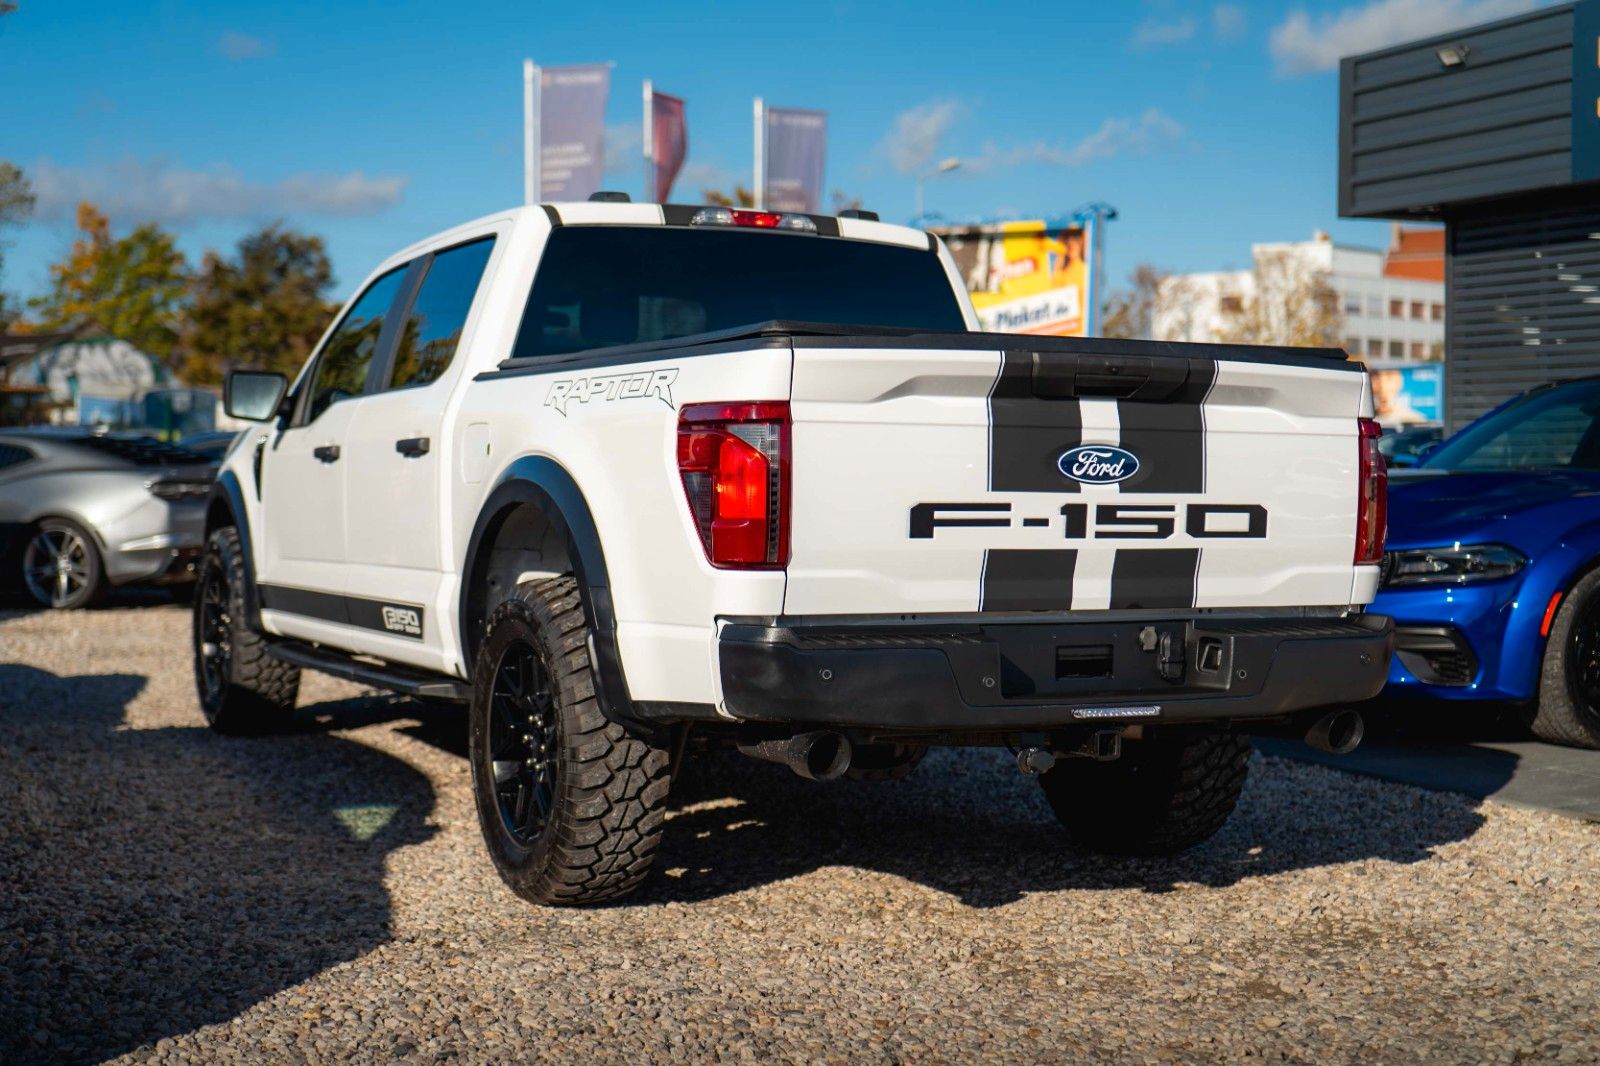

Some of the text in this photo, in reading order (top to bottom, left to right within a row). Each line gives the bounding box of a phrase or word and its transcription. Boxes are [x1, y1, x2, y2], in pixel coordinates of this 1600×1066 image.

[544, 368, 679, 417] RAPTOR
[1072, 450, 1124, 477] Ford
[909, 502, 1268, 539] F-150
